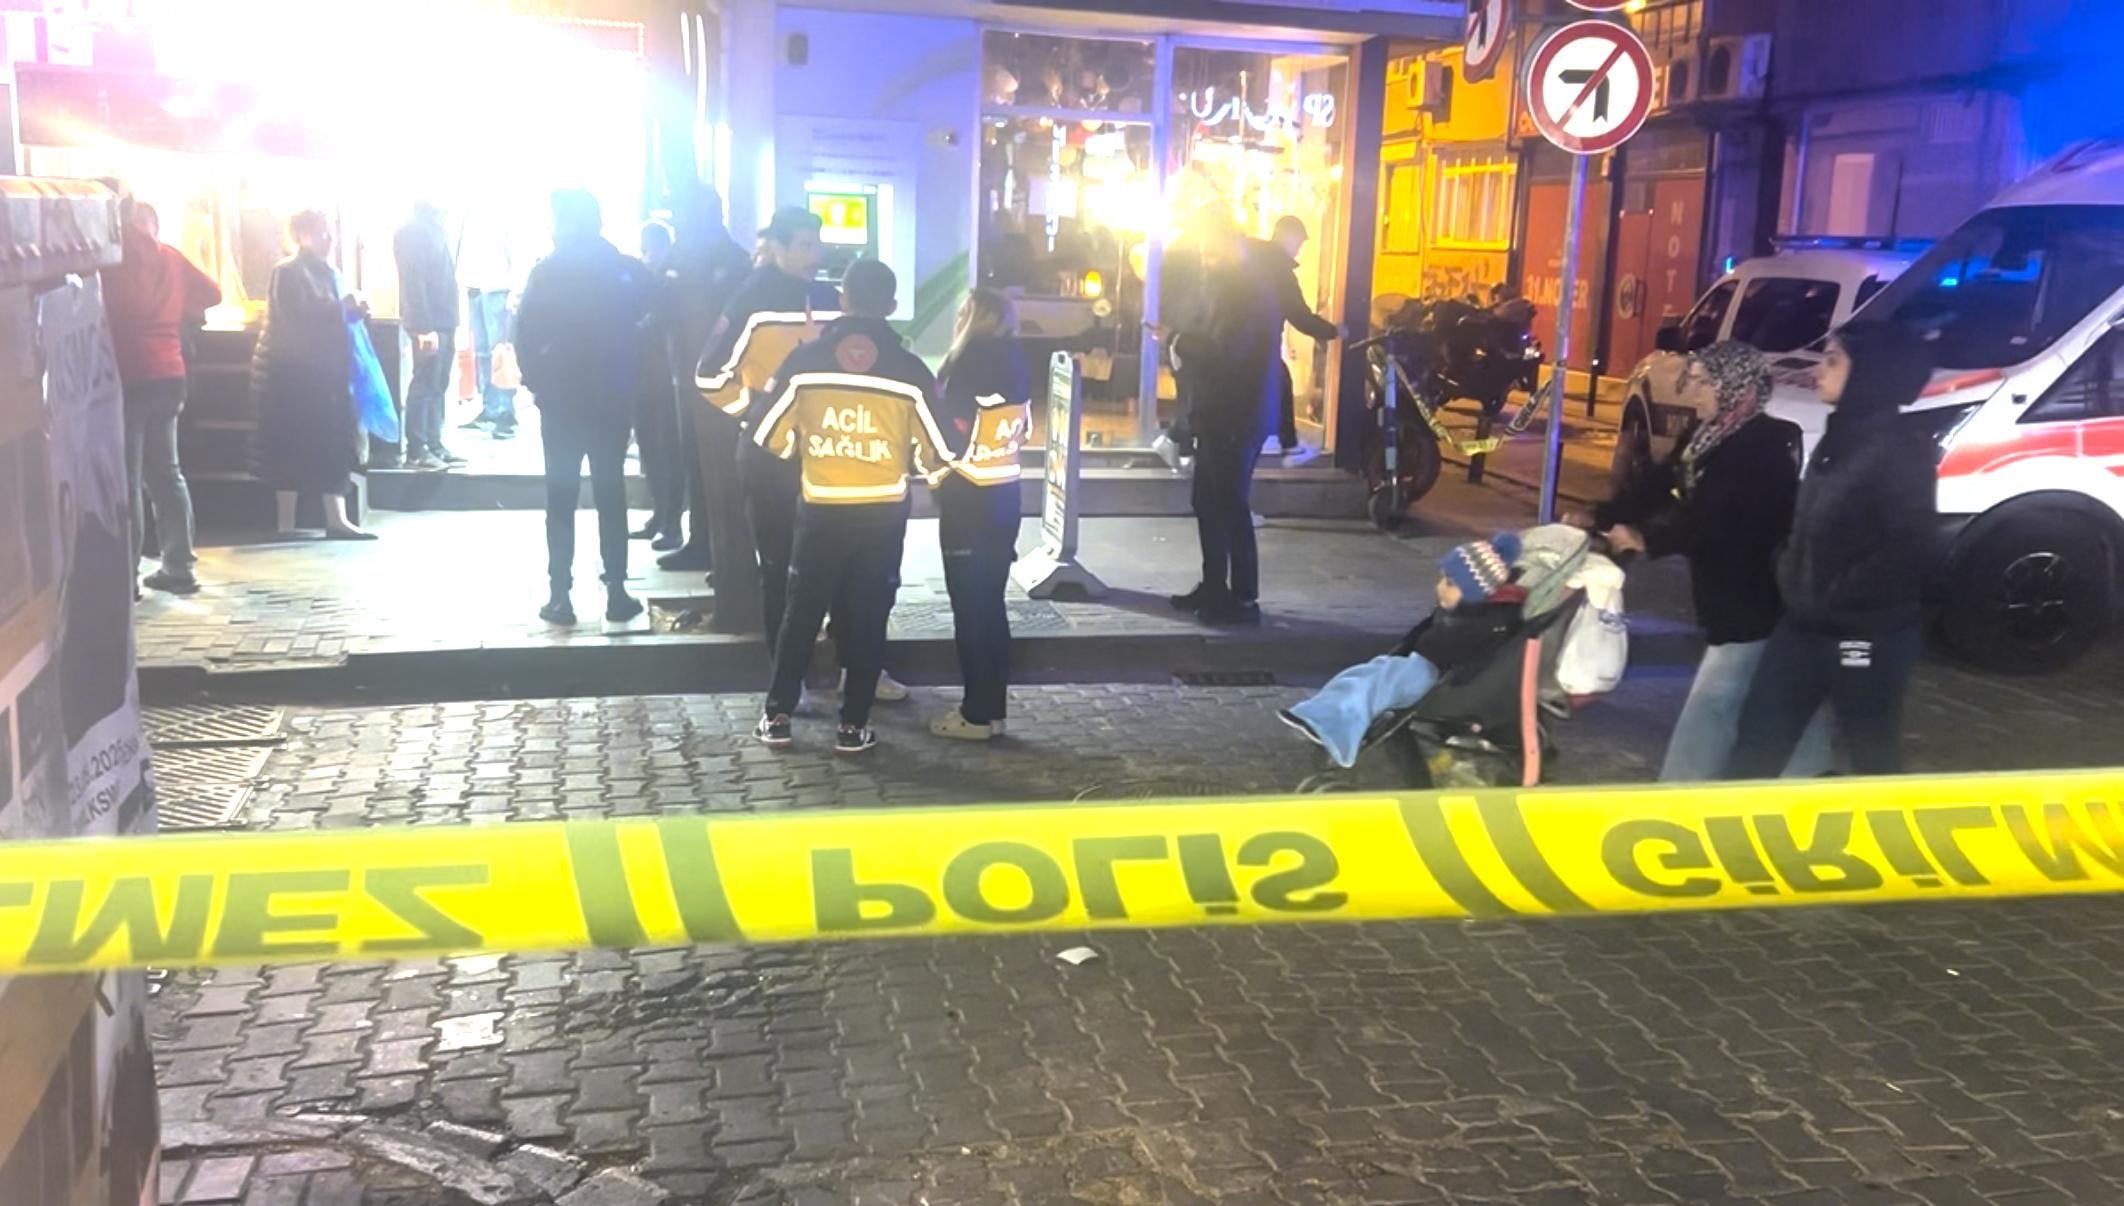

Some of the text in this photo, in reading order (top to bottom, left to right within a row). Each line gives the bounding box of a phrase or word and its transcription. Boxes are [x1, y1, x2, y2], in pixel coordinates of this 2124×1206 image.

[1523, 274, 1589, 309] 31.NOER
[821, 403, 878, 434] ACİL
[808, 434, 892, 463] SAĞLIK
